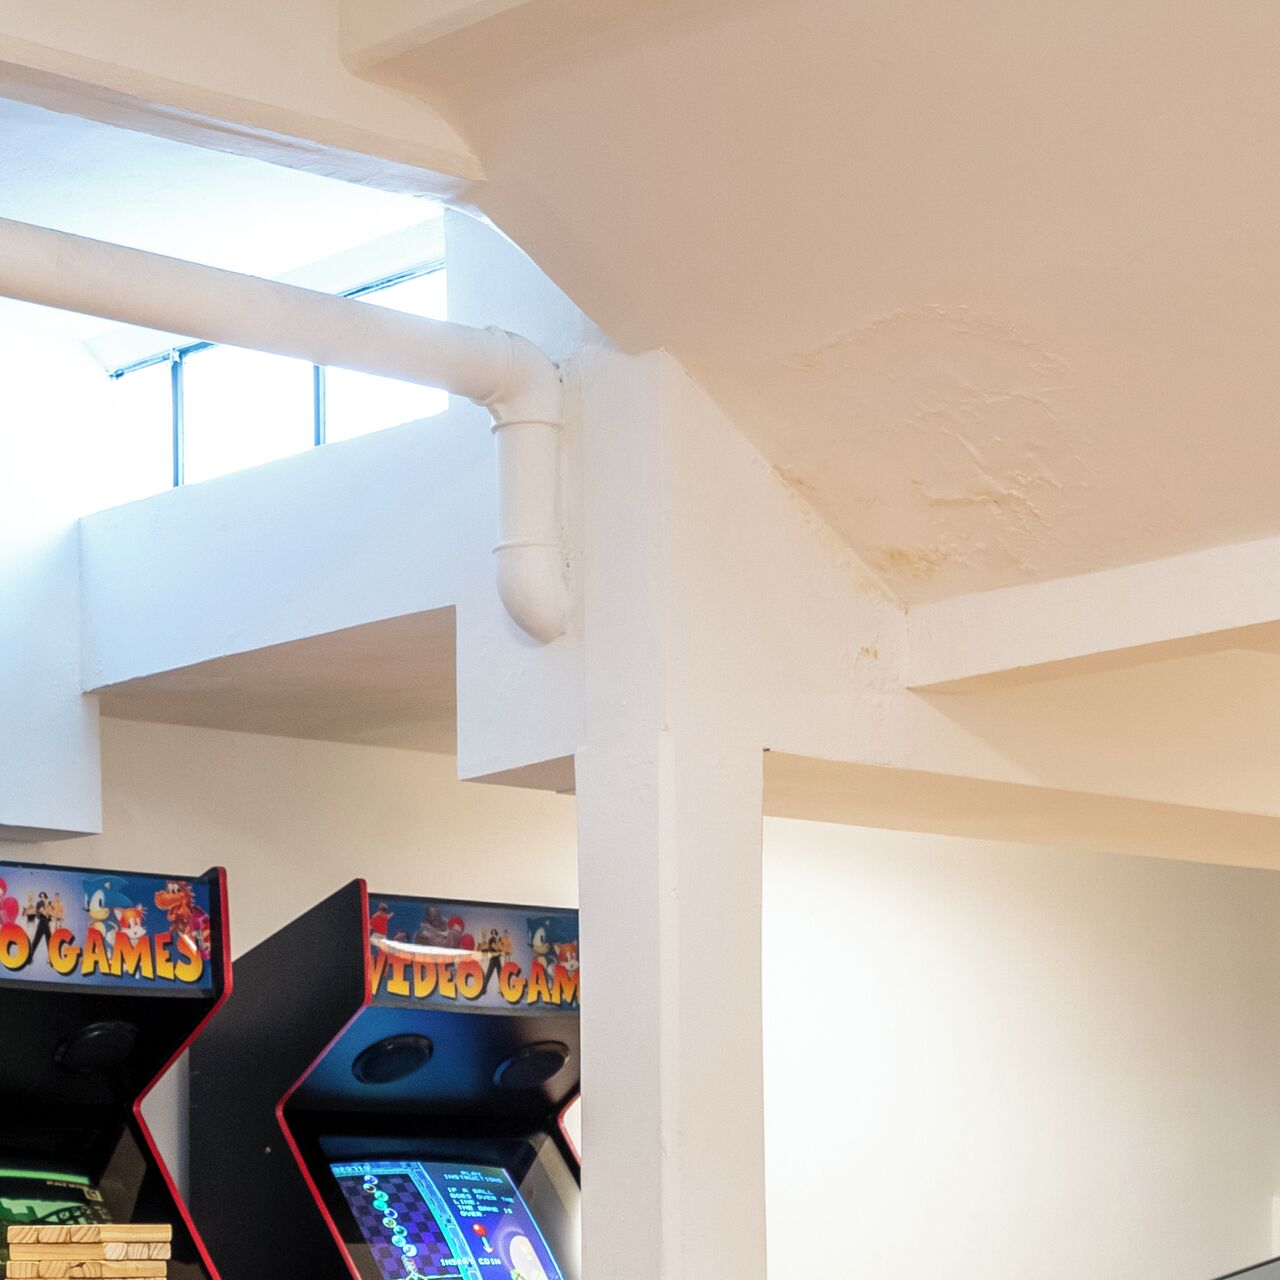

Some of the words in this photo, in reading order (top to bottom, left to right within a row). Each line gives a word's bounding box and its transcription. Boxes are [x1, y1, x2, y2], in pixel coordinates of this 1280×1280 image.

[48, 927, 204, 984] GAMES
[370, 948, 484, 999] VIDEO
[499, 959, 579, 1005] GAM
[477, 1257, 502, 1265] COIN
